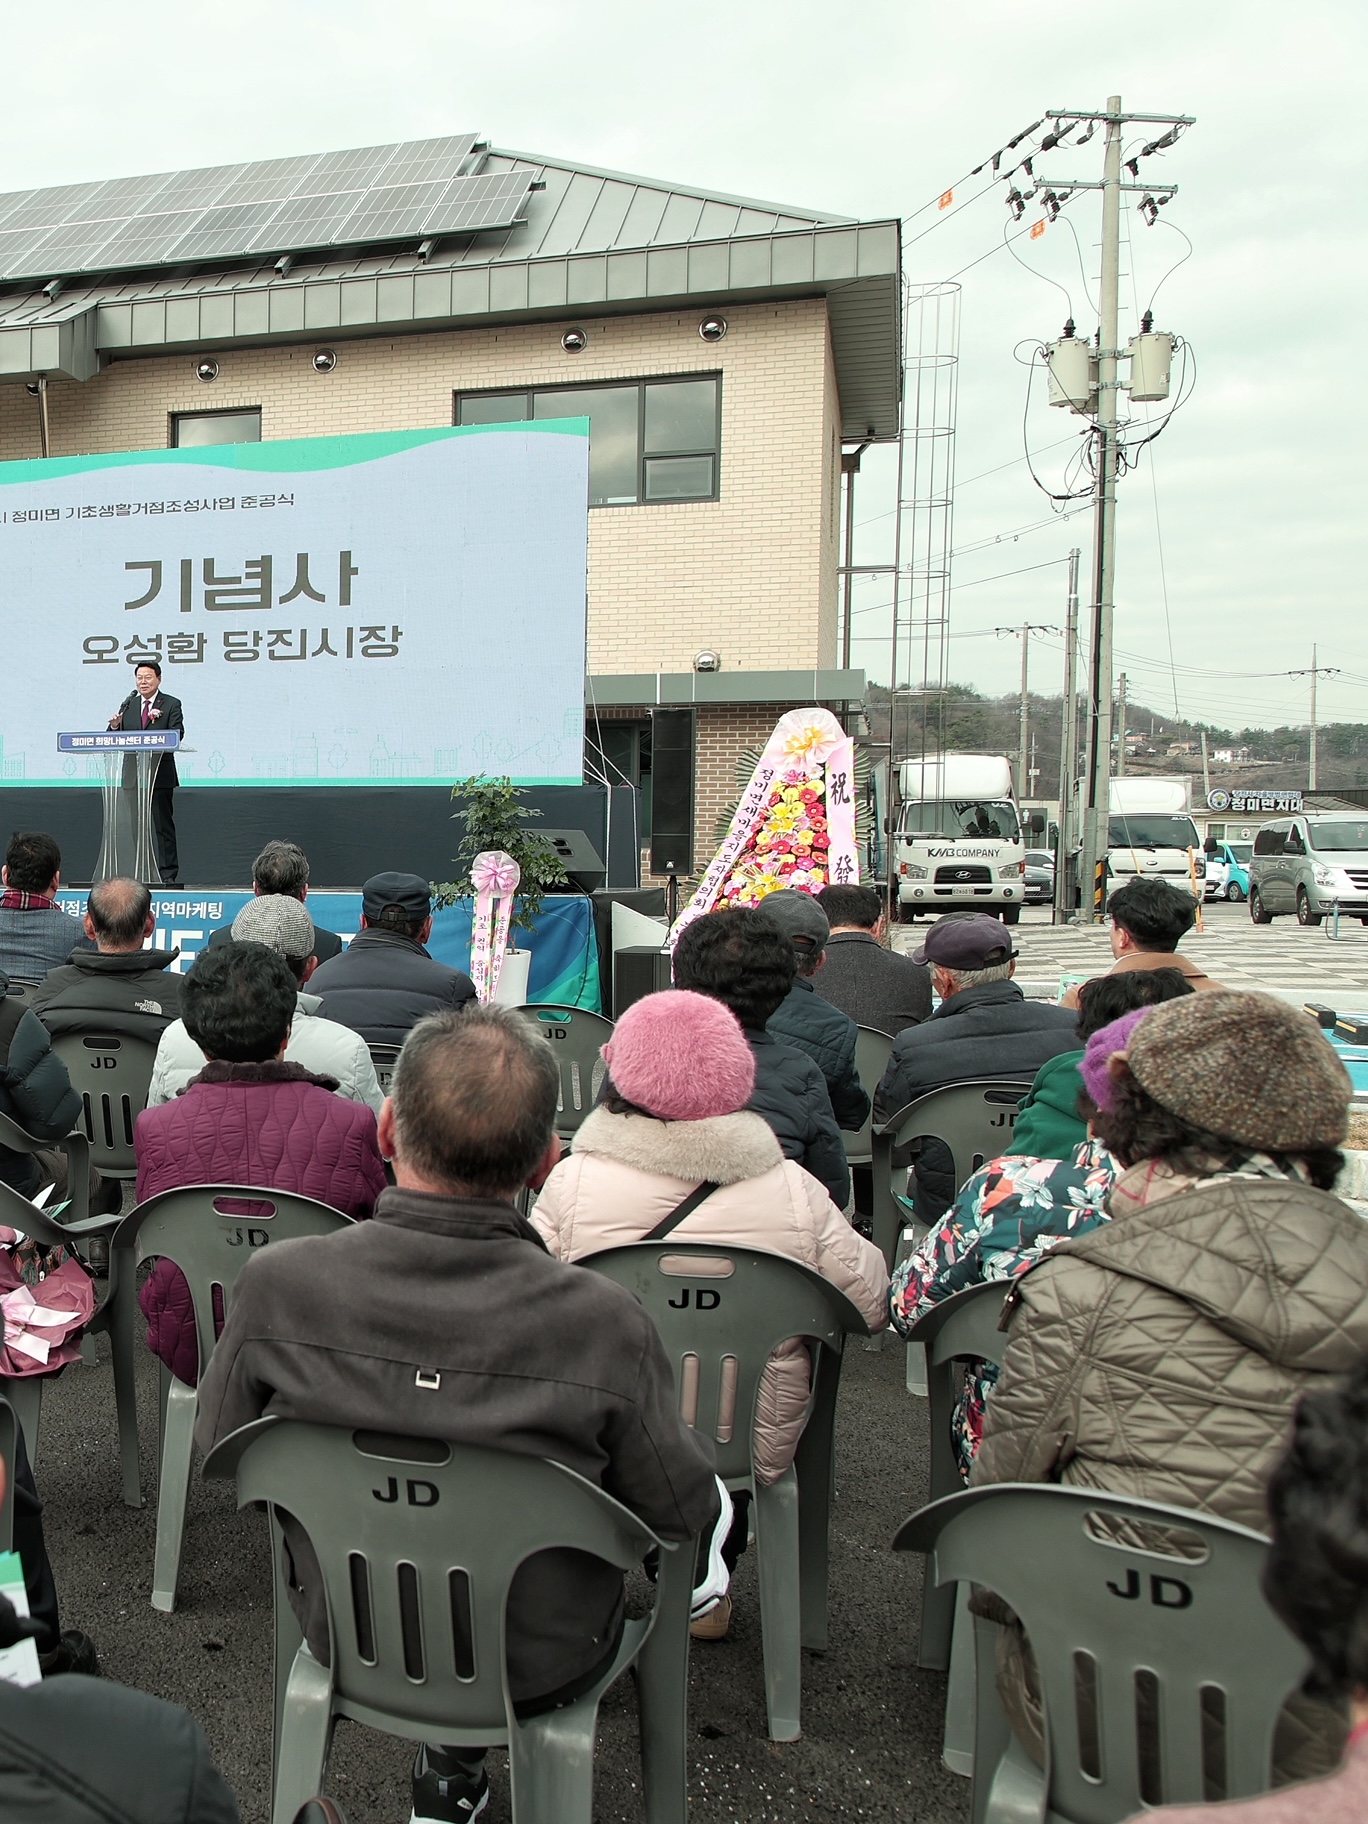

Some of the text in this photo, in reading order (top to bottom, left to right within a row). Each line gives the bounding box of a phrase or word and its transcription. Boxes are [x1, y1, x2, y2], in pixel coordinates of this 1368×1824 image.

[12, 509, 61, 523] 정미면
[66, 497, 236, 520] 기초생활거점조성사업
[240, 493, 295, 509] 준공식
[123, 550, 359, 613] 기념사
[82, 625, 403, 665] 오성환 당진시장
[72, 737, 95, 746] 정미면
[143, 735, 165, 745] 준공식
[830, 772, 851, 806] 祝
[1231, 798, 1304, 812] 정미면지대
[956, 848, 1001, 858] COMPANY
[543, 1028, 567, 1040] JD
[90, 1056, 117, 1070] JD
[225, 1227, 270, 1249] JD
[668, 1288, 722, 1311] JD
[371, 1476, 441, 1508] JD
[1106, 1568, 1194, 1611] JD
